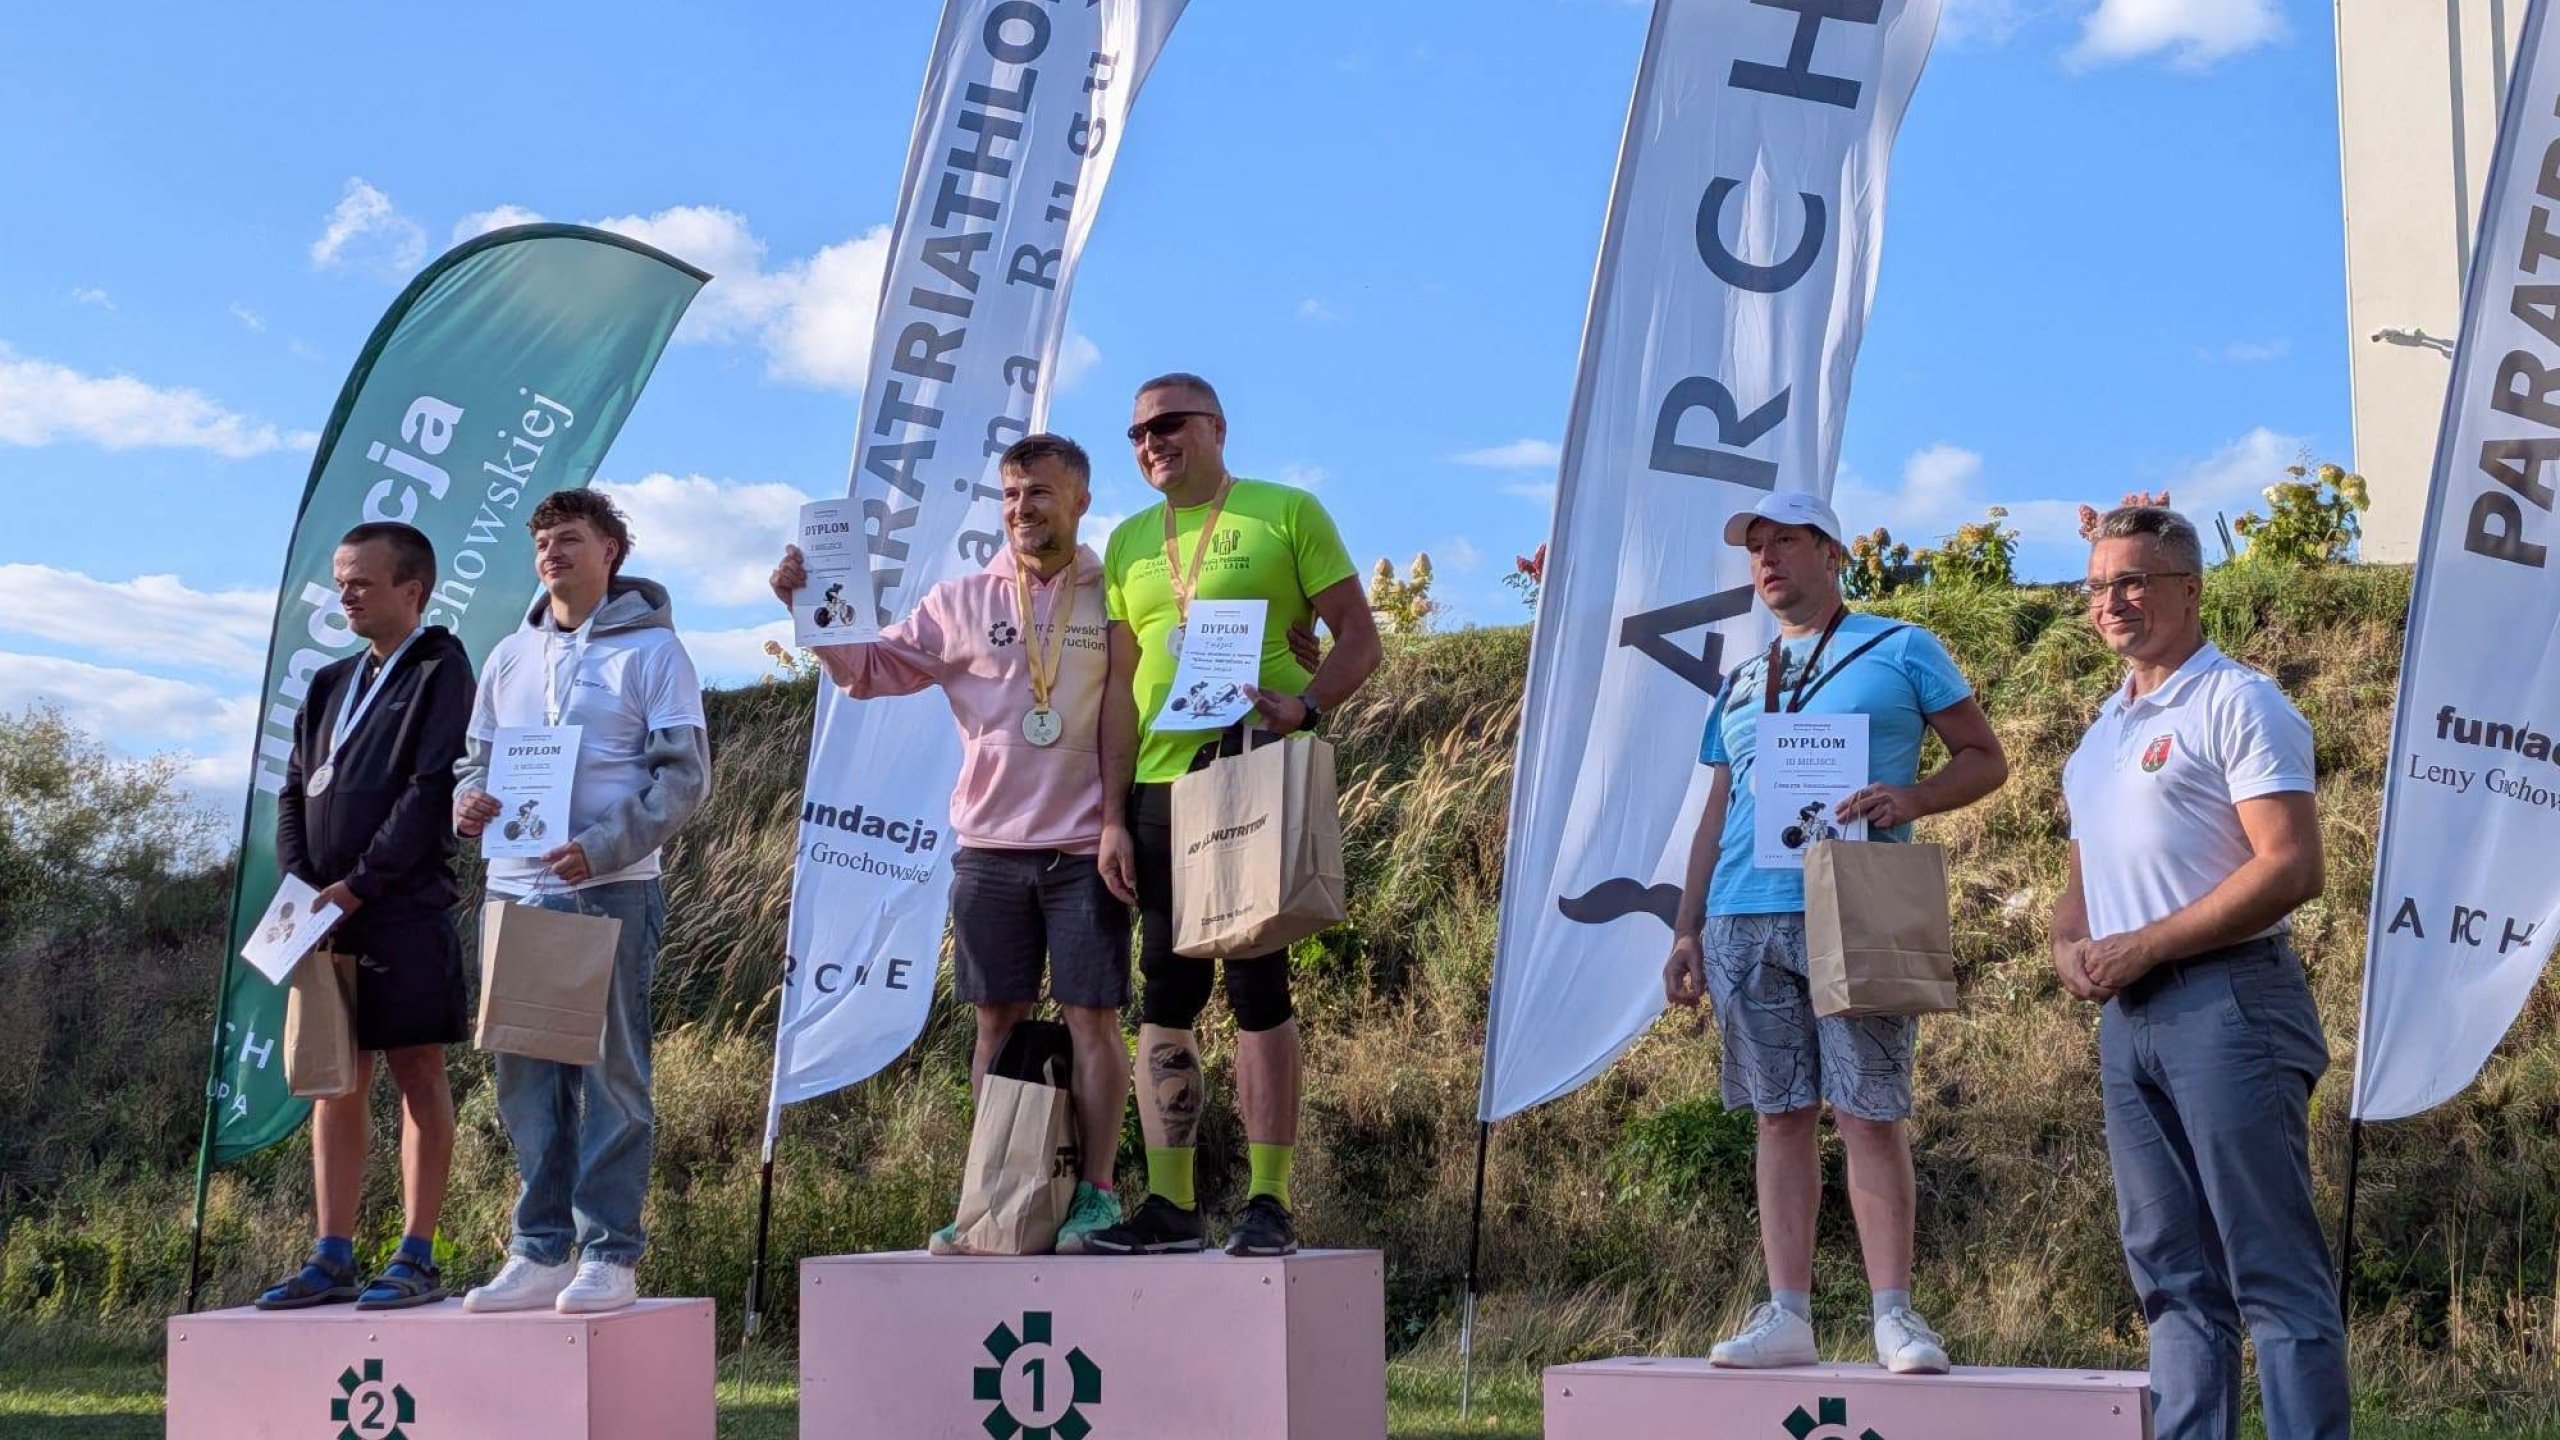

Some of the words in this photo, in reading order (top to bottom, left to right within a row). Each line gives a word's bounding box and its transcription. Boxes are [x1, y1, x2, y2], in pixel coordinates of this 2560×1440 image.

[862, 0, 1060, 628] ARATRIATHLO
[428, 387, 575, 636] chowskiej
[805, 522, 850, 536] DYPLOM
[1201, 623, 1249, 635] DYPLOM
[508, 745, 562, 757] DYPLOM
[1778, 737, 1846, 749] DYPLOM
[2408, 753, 2476, 794] Leny
[801, 800, 938, 854] undacja
[1022, 1358, 1045, 1412] 1
[361, 1391, 385, 1430] 2
